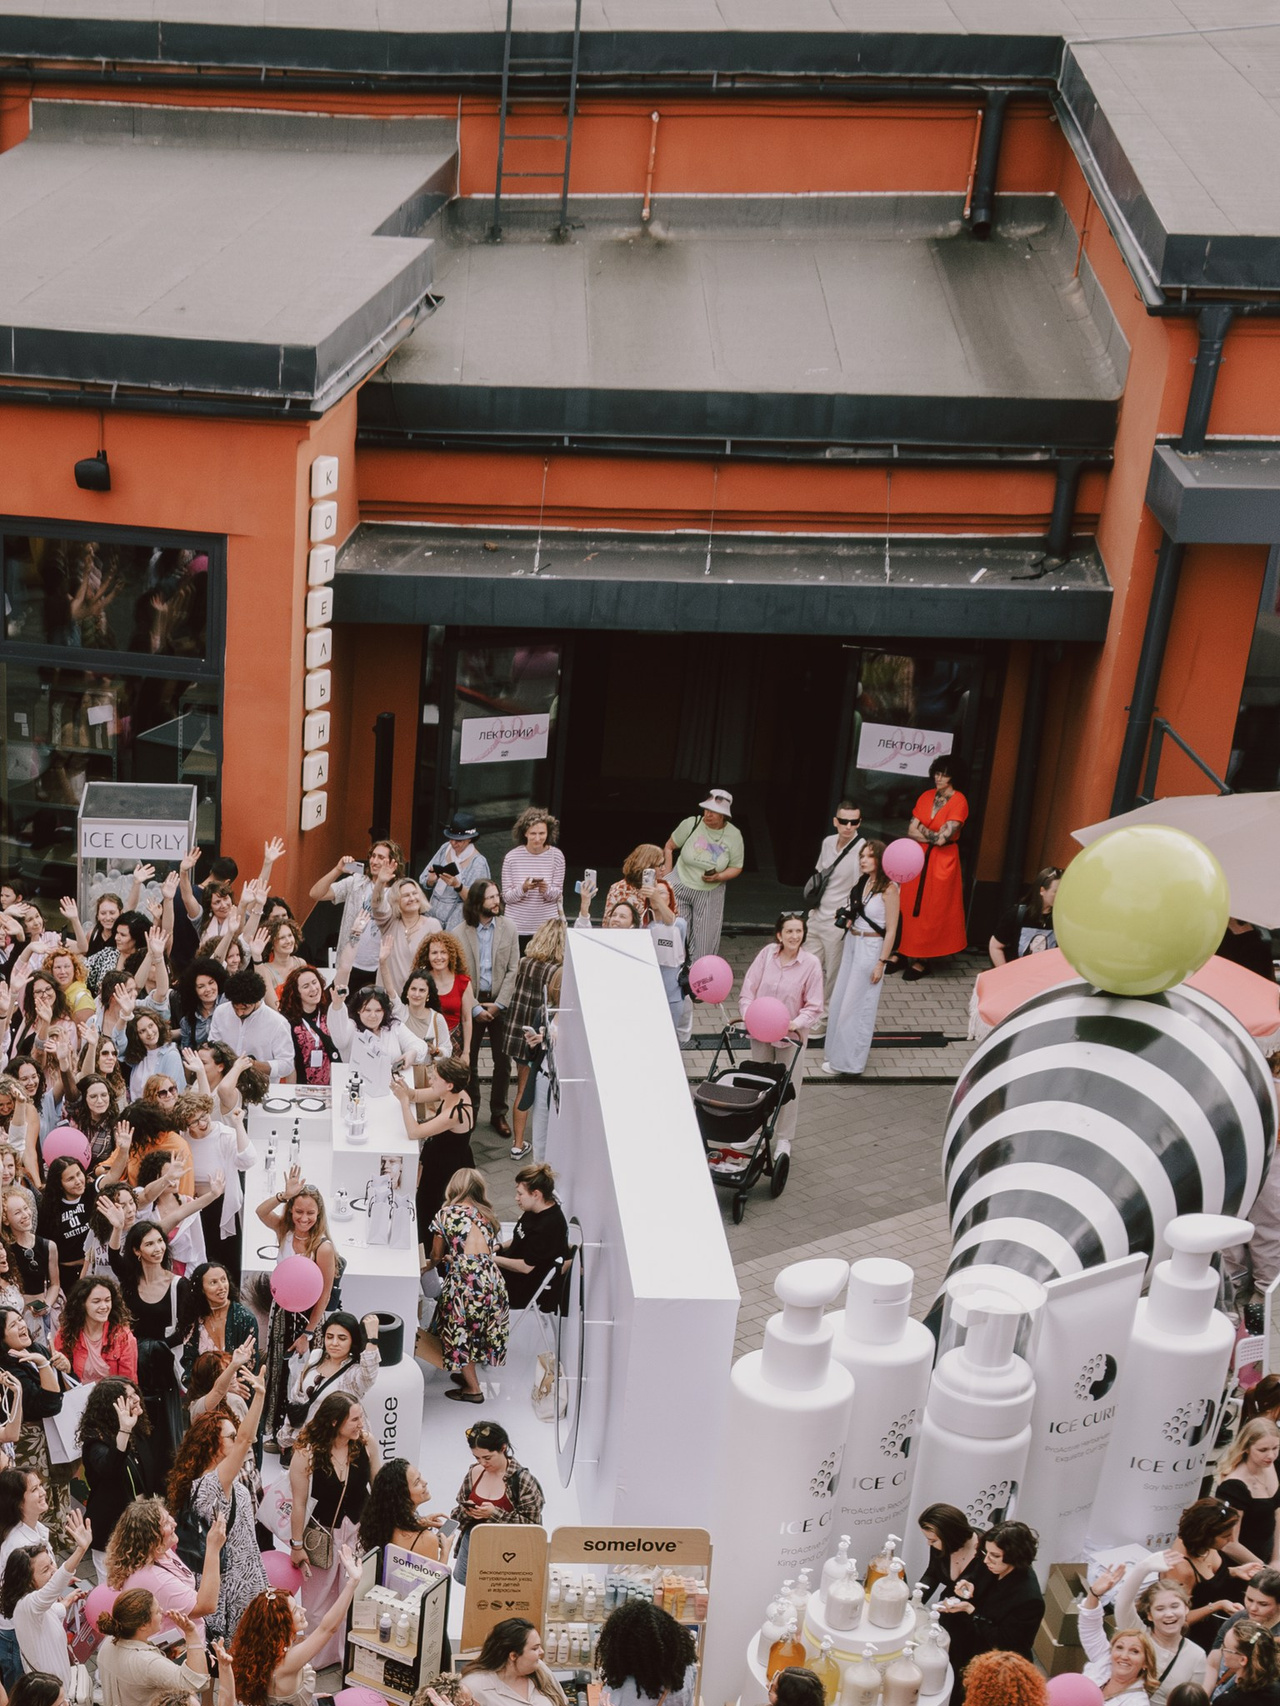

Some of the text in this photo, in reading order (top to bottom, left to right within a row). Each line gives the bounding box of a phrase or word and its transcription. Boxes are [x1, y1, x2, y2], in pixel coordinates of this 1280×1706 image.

[315, 470, 333, 818] КОТЕЛЬНАЯ
[479, 727, 534, 740] ЛЕКТОРИЙ
[878, 739, 936, 753] ЛЕКТОРИЙ
[83, 832, 185, 850] ICE CURLY
[1048, 1419, 1079, 1434] ICE
[1130, 1456, 1166, 1473] ICE
[852, 1476, 886, 1491] ICE
[841, 1504, 886, 1515] ProActive
[779, 1518, 814, 1535] ICE
[854, 1517, 872, 1526] and
[583, 1538, 677, 1552] somelove
[392, 1555, 441, 1580] somelove
[777, 1560, 797, 1568] King
